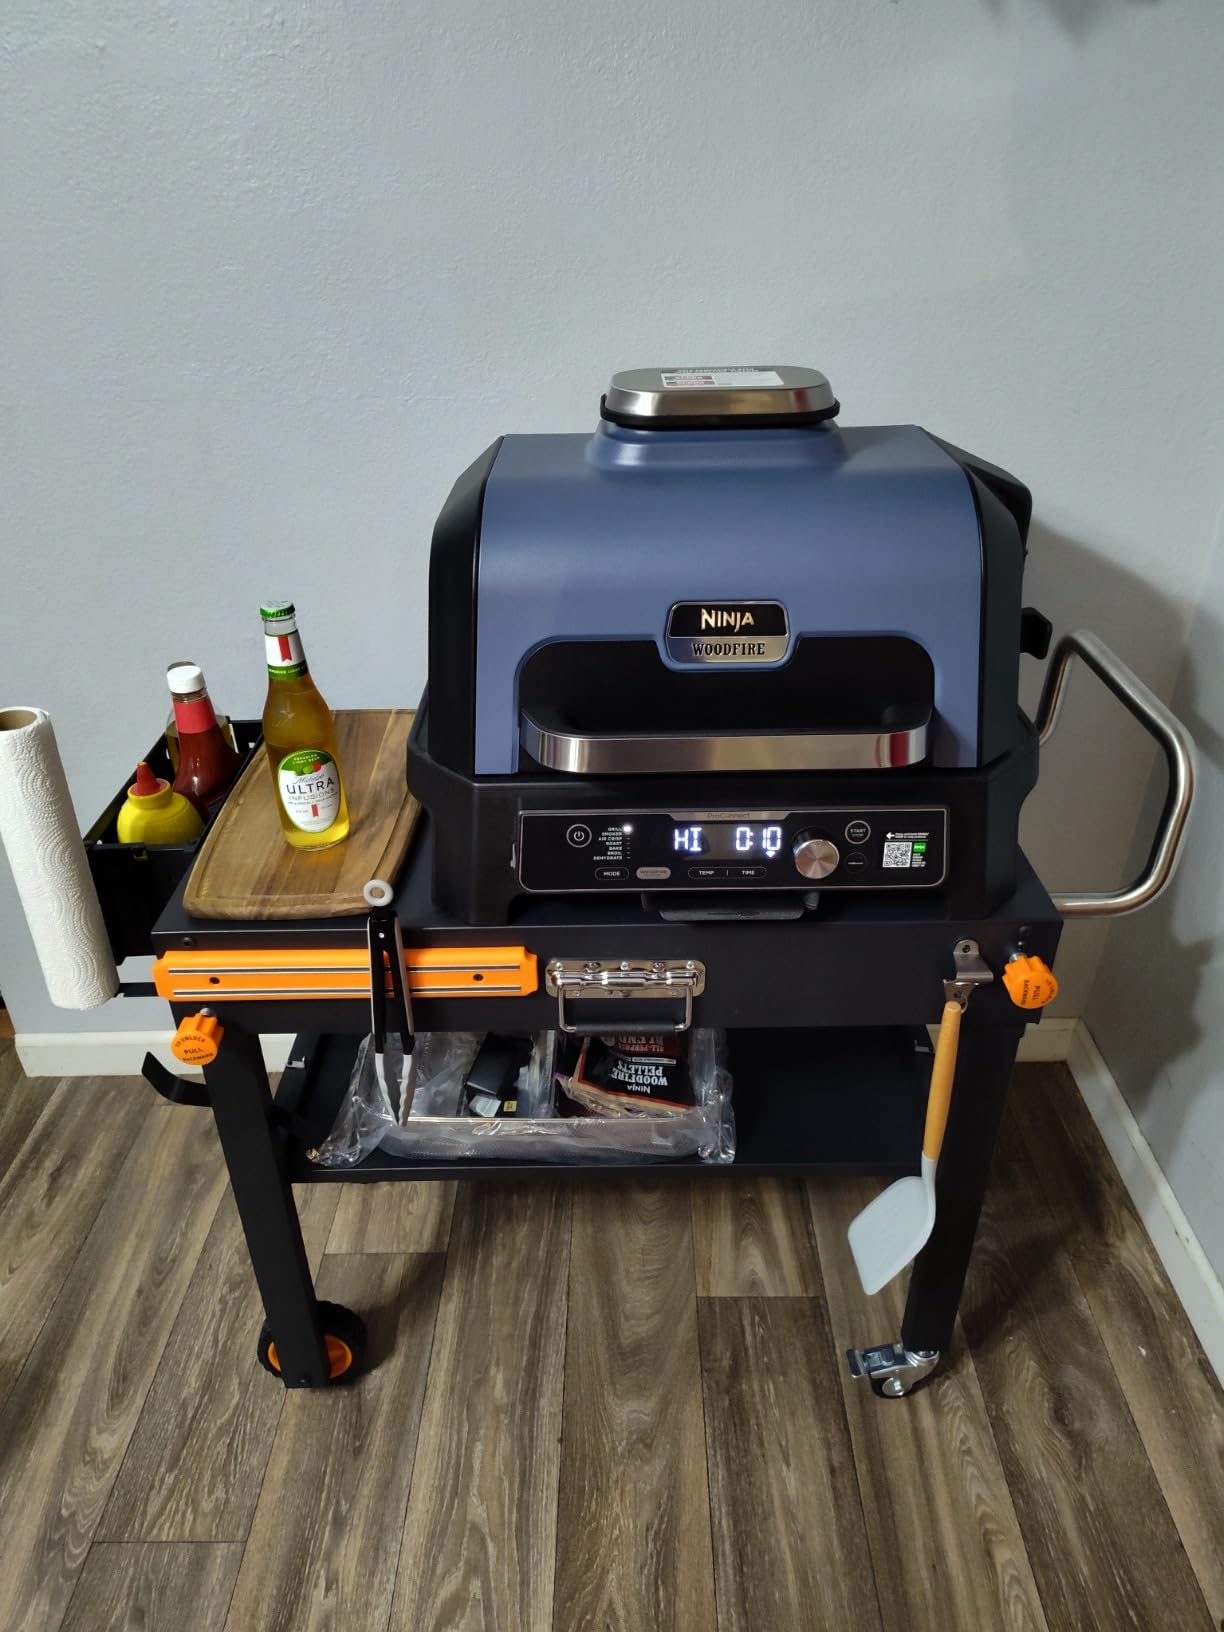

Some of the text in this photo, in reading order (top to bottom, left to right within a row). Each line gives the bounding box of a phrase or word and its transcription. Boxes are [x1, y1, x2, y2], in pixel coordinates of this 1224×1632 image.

[701, 608, 754, 632] NINJA
[692, 643, 765, 656] WOODFIRE
[286, 777, 334, 794] ULTRA
[289, 788, 336, 801] INFUSIONS
[674, 826, 782, 851] HI 0:10
[1032, 985, 1041, 1001] PULL
[617, 1060, 663, 1076] PELLETS
[611, 1067, 668, 1086] WOODFIRE
[627, 1084, 651, 1094] NINJA
